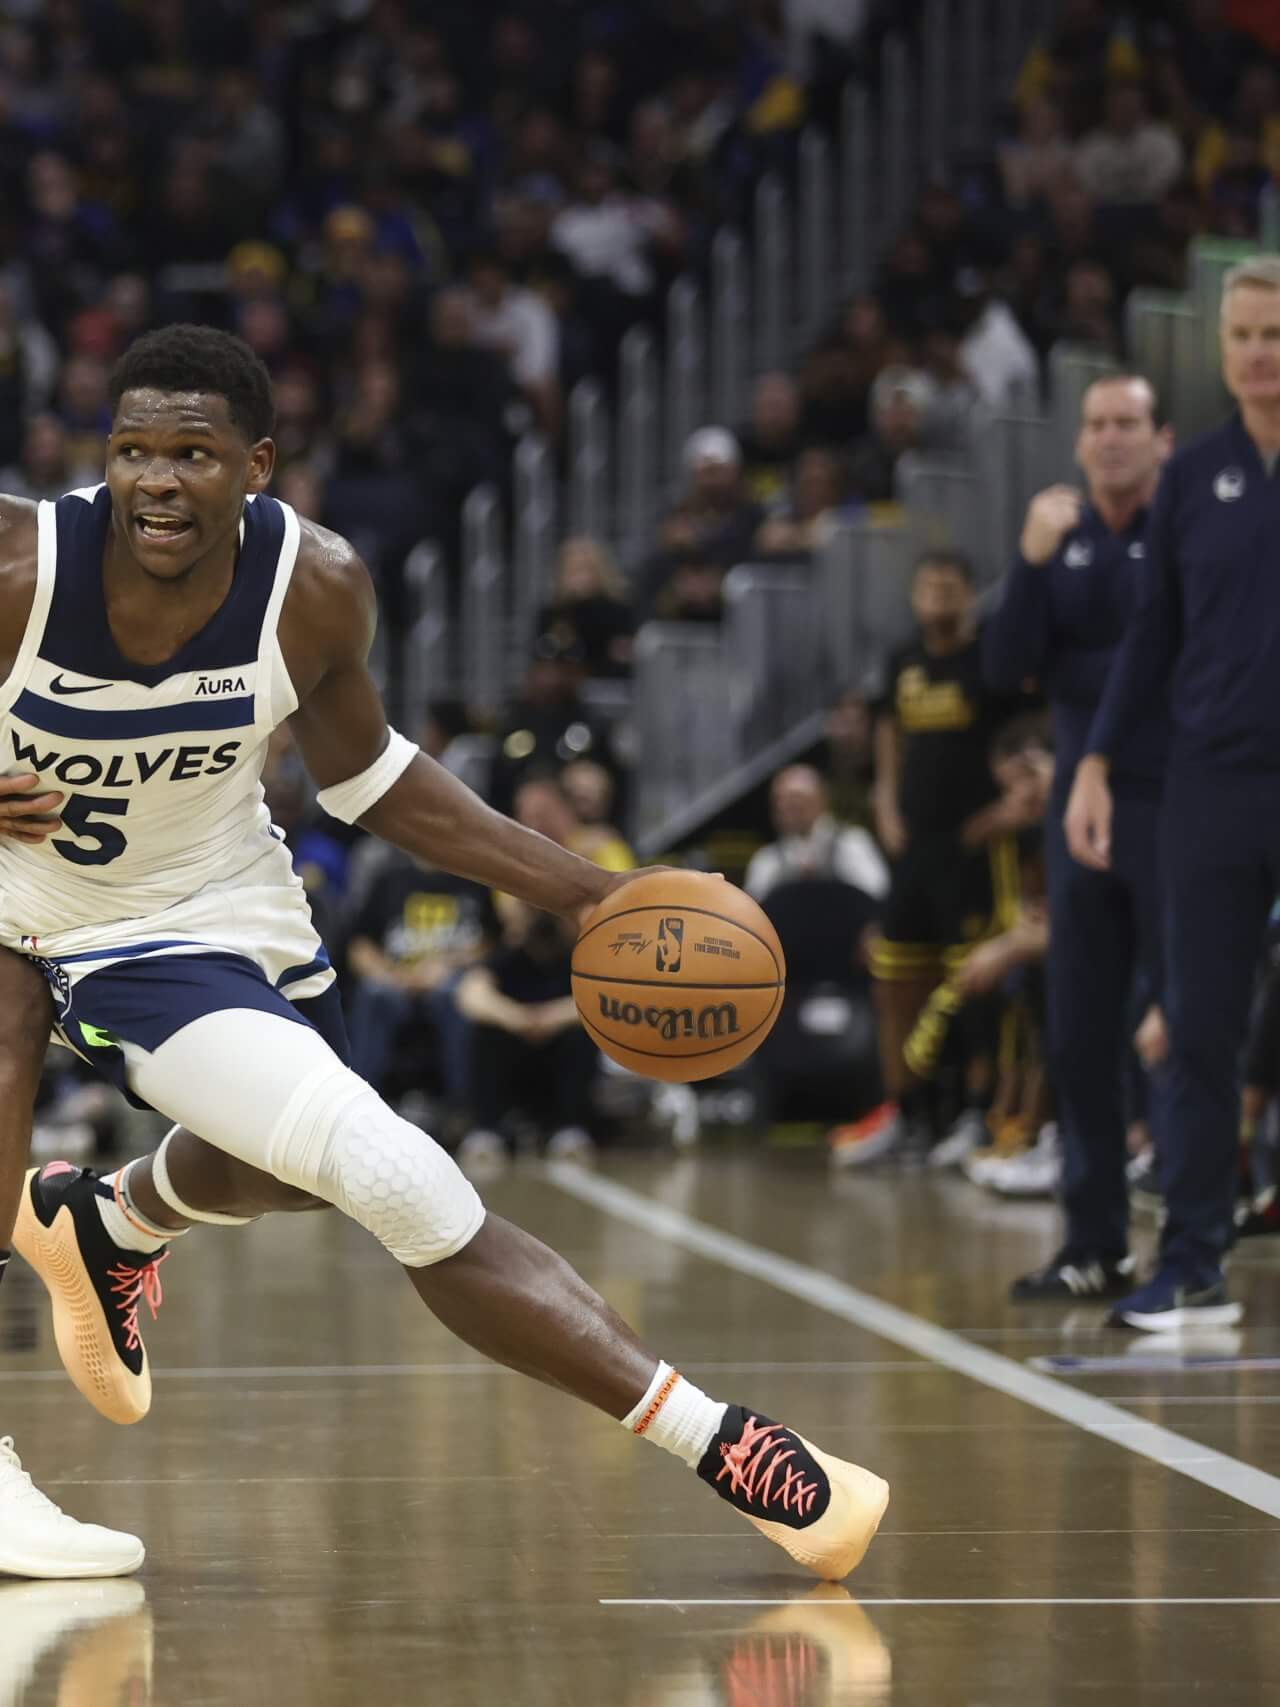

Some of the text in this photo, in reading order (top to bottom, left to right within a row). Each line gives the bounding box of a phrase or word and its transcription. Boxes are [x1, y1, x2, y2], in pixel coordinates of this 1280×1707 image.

[11, 728, 242, 787] WOLVES
[51, 793, 130, 865] 5
[598, 992, 740, 1040] Wilson
